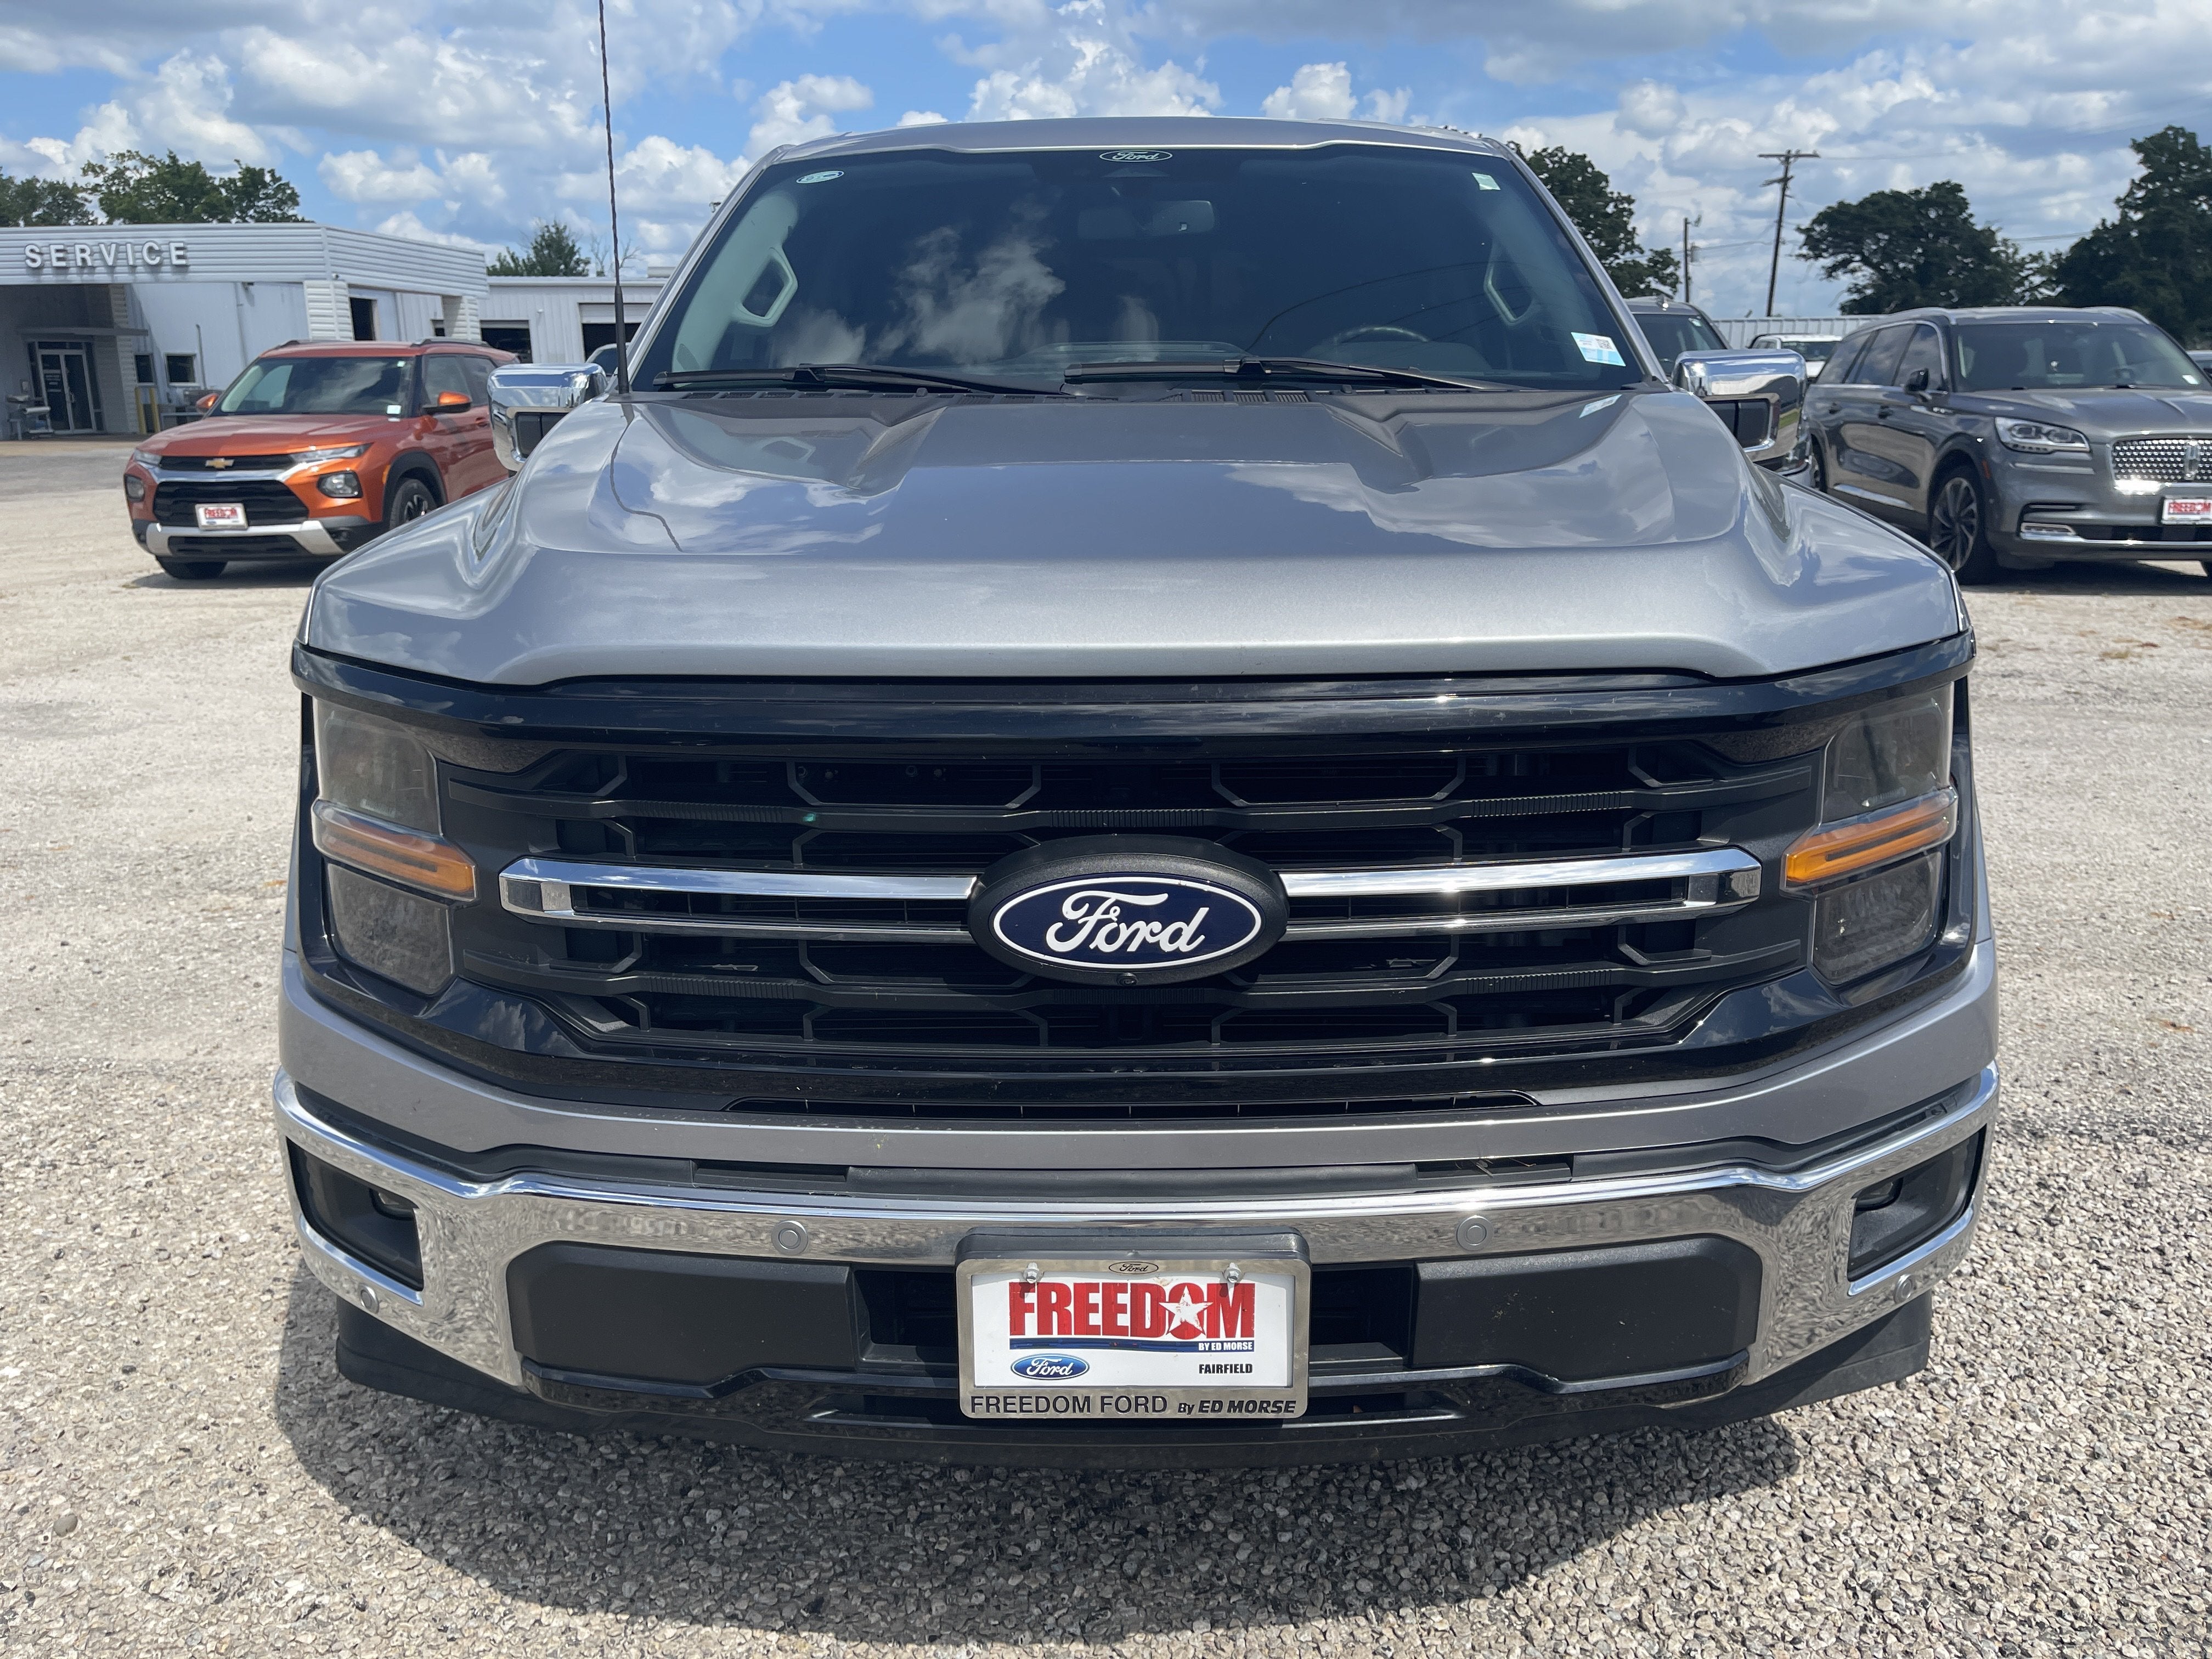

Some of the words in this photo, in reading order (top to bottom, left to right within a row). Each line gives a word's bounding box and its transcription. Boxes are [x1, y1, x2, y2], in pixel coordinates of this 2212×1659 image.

[1112, 151, 1159, 160] Ford
[25, 241, 187, 268] SERVICE
[1046, 890, 1209, 952] Ford
[1119, 1263, 1149, 1272] Ford
[1009, 1282, 1255, 1340] FREEDOM
[1198, 1342, 1210, 1351] BY
[1211, 1342, 1222, 1351] ED
[1223, 1342, 1252, 1350] MORSE
[1026, 1357, 1074, 1375] Ford
[1199, 1364, 1253, 1374] FAIRFIELD
[970, 1395, 1091, 1414] FREEDOM
[1101, 1395, 1167, 1414] FORD
[1178, 1402, 1195, 1415] By
[1198, 1400, 1223, 1414] ED
[1226, 1400, 1296, 1414] MORSE
